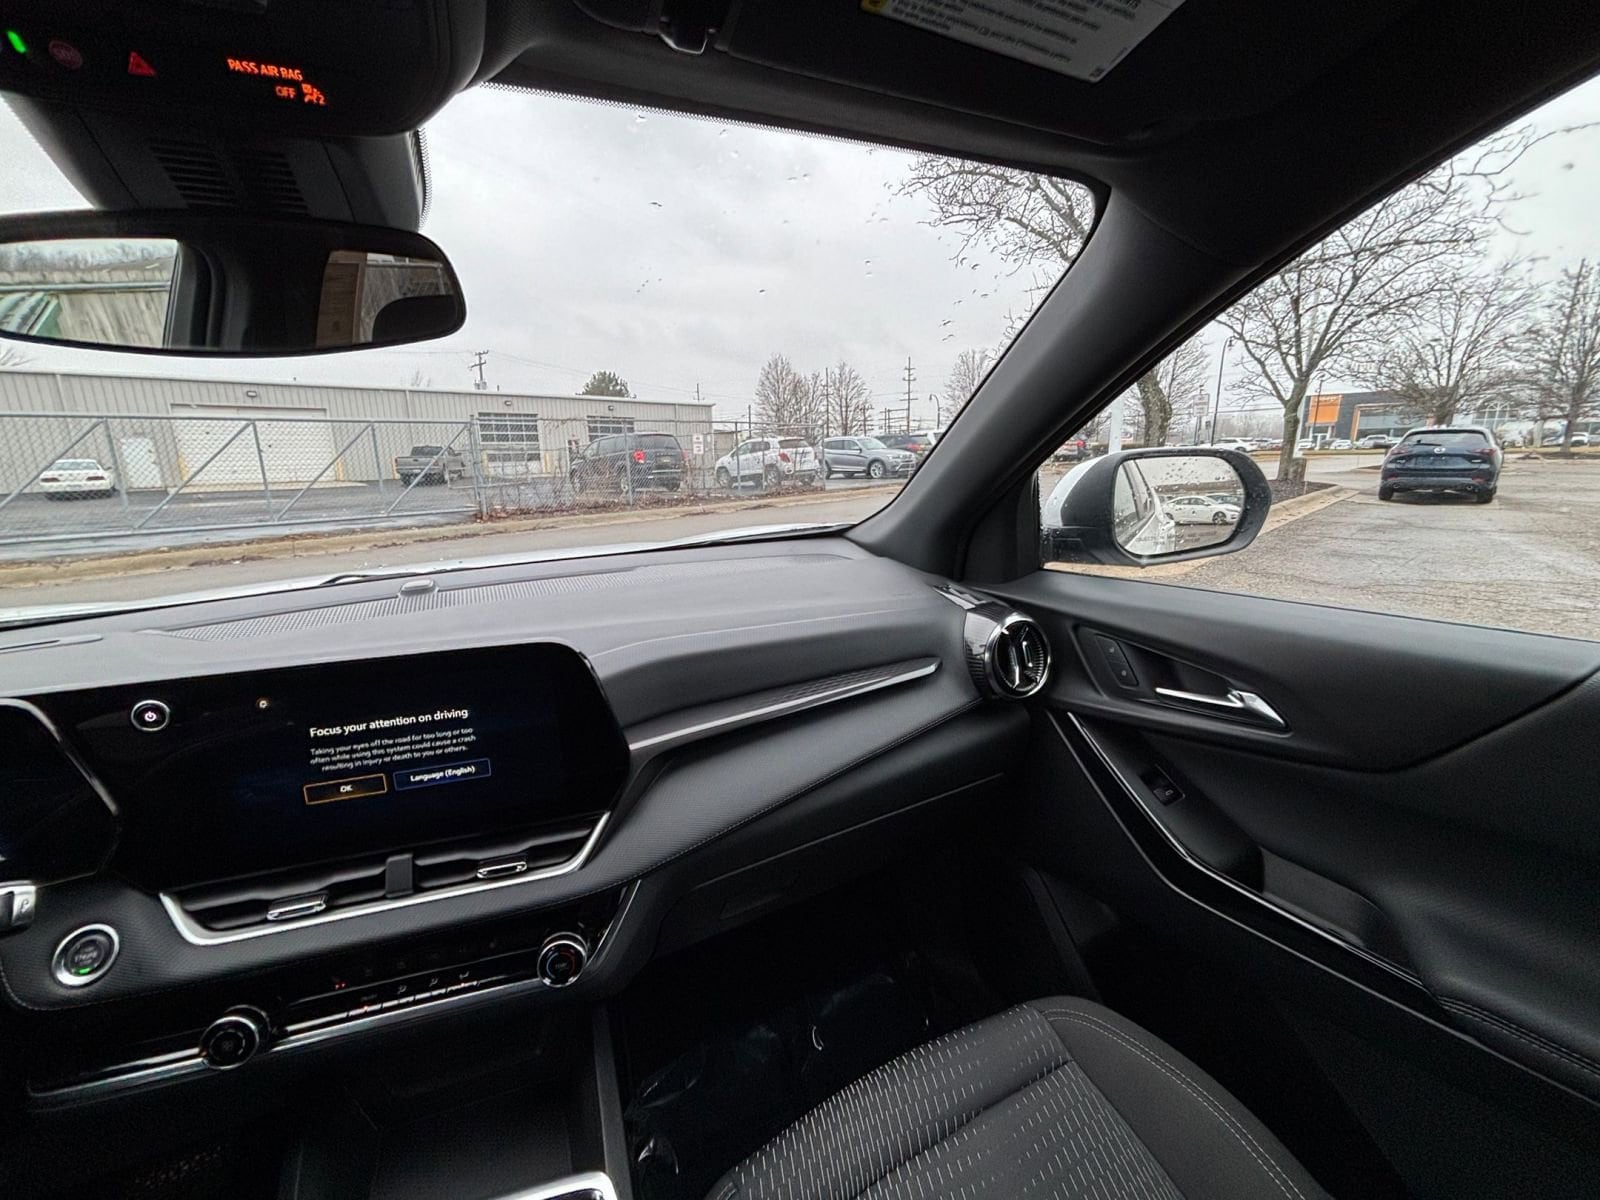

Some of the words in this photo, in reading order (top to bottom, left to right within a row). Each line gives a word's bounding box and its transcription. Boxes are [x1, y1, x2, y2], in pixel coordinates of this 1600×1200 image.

[227, 58, 259, 74] PASS
[260, 64, 280, 77] AIR
[280, 67, 303, 81] BAG
[275, 86, 296, 98] OFF
[309, 727, 342, 738] Focus
[343, 723, 368, 736] your
[369, 716, 417, 730] attention
[418, 714, 432, 723] on
[433, 709, 469, 721] driving
[310, 757, 331, 765] often
[351, 751, 371, 759] using
[386, 746, 411, 755] system
[411, 741, 431, 749] could
[431, 739, 451, 747] cause
[457, 735, 477, 743] crash
[352, 743, 370, 751] eyes
[370, 739, 380, 747] off
[395, 735, 411, 743] road
[321, 763, 354, 772] resulting
[362, 758, 383, 766] injury
[392, 753, 413, 761] death
[410, 772, 445, 783] Language
[444, 765, 476, 778] (English)
[339, 784, 353, 793] OK
